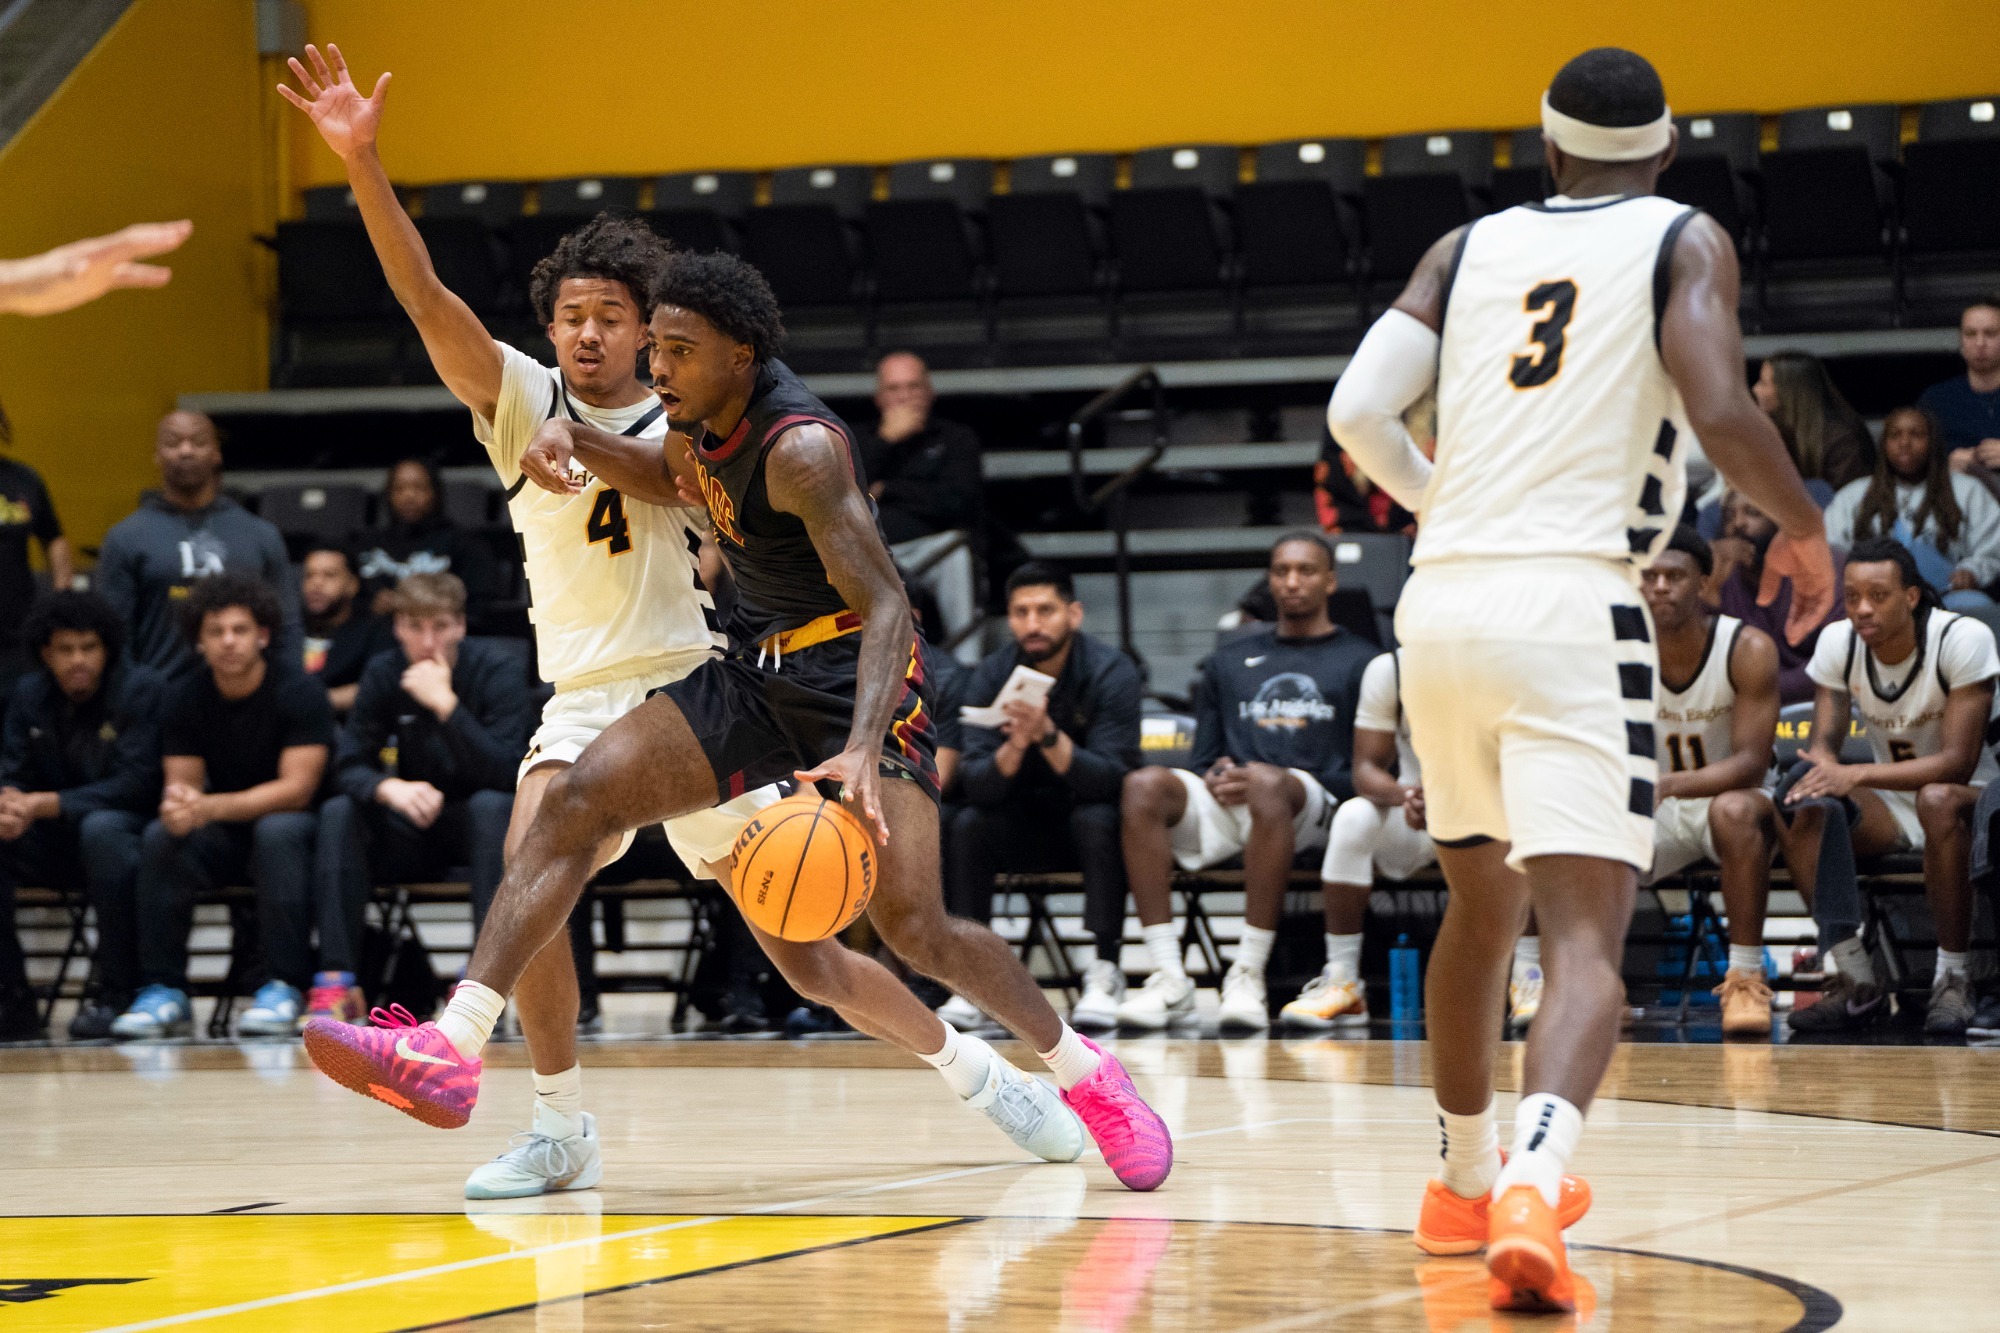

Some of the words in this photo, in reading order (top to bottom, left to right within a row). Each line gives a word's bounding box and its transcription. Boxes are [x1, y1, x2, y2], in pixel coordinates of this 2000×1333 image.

[1507, 276, 1580, 392] 3
[585, 486, 634, 558] 4
[1665, 732, 1708, 773] 11
[756, 876, 772, 906] NFHS
